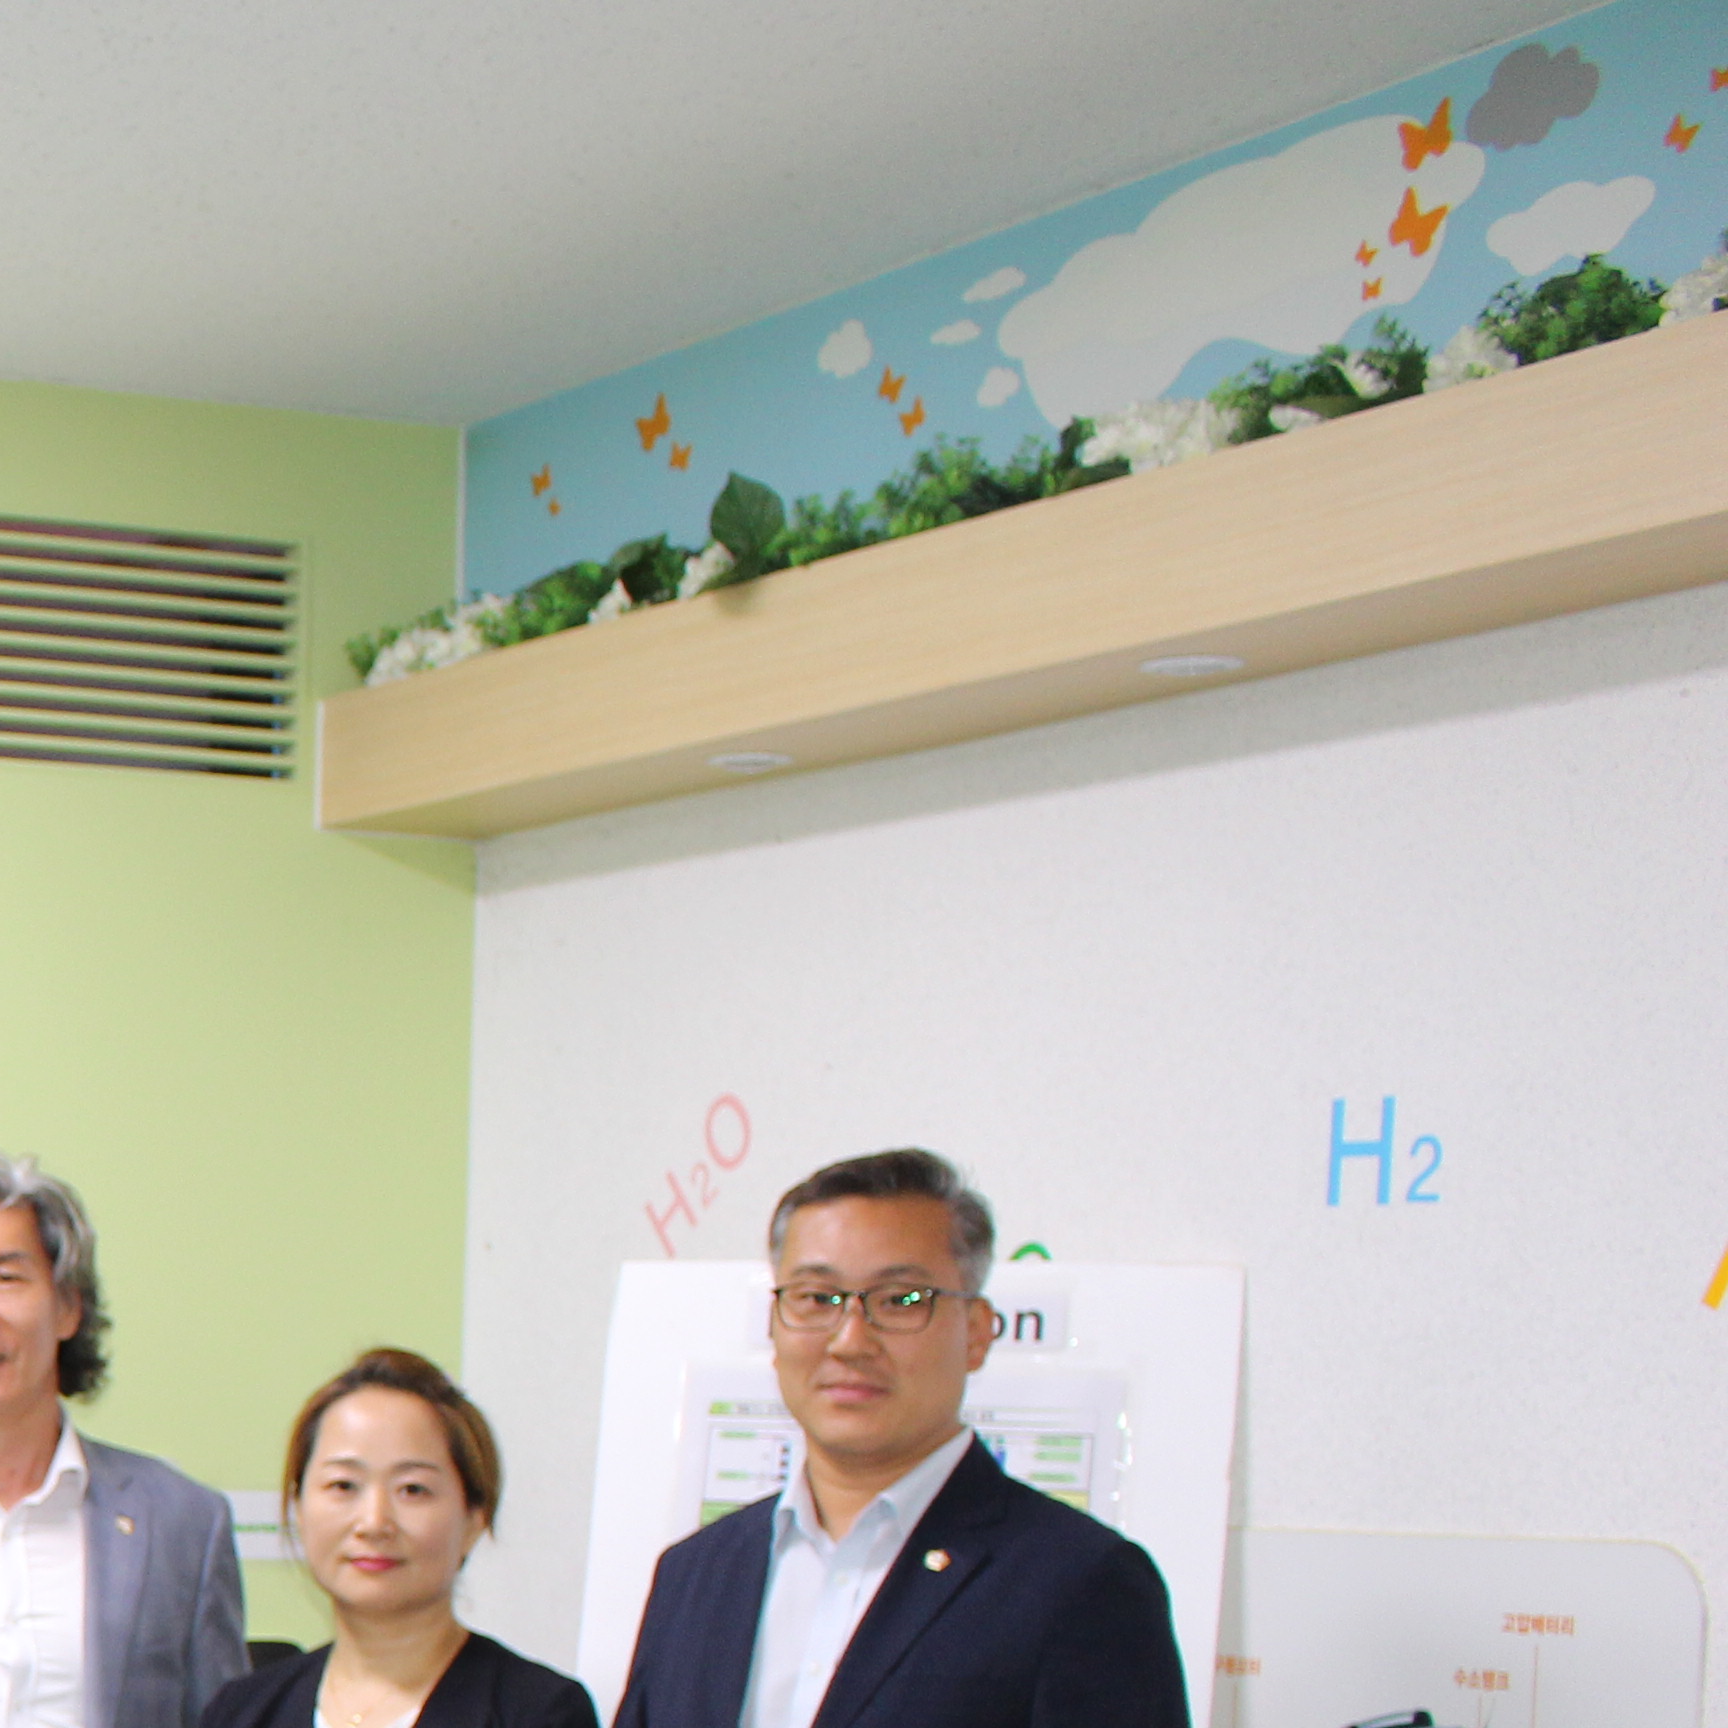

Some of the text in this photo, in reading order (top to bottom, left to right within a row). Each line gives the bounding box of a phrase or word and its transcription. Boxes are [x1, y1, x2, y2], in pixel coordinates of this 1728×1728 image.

[644, 1091, 753, 1259] H2O
[1326, 1094, 1443, 1206] H2
[1453, 1668, 1511, 1692] 수소탱크
